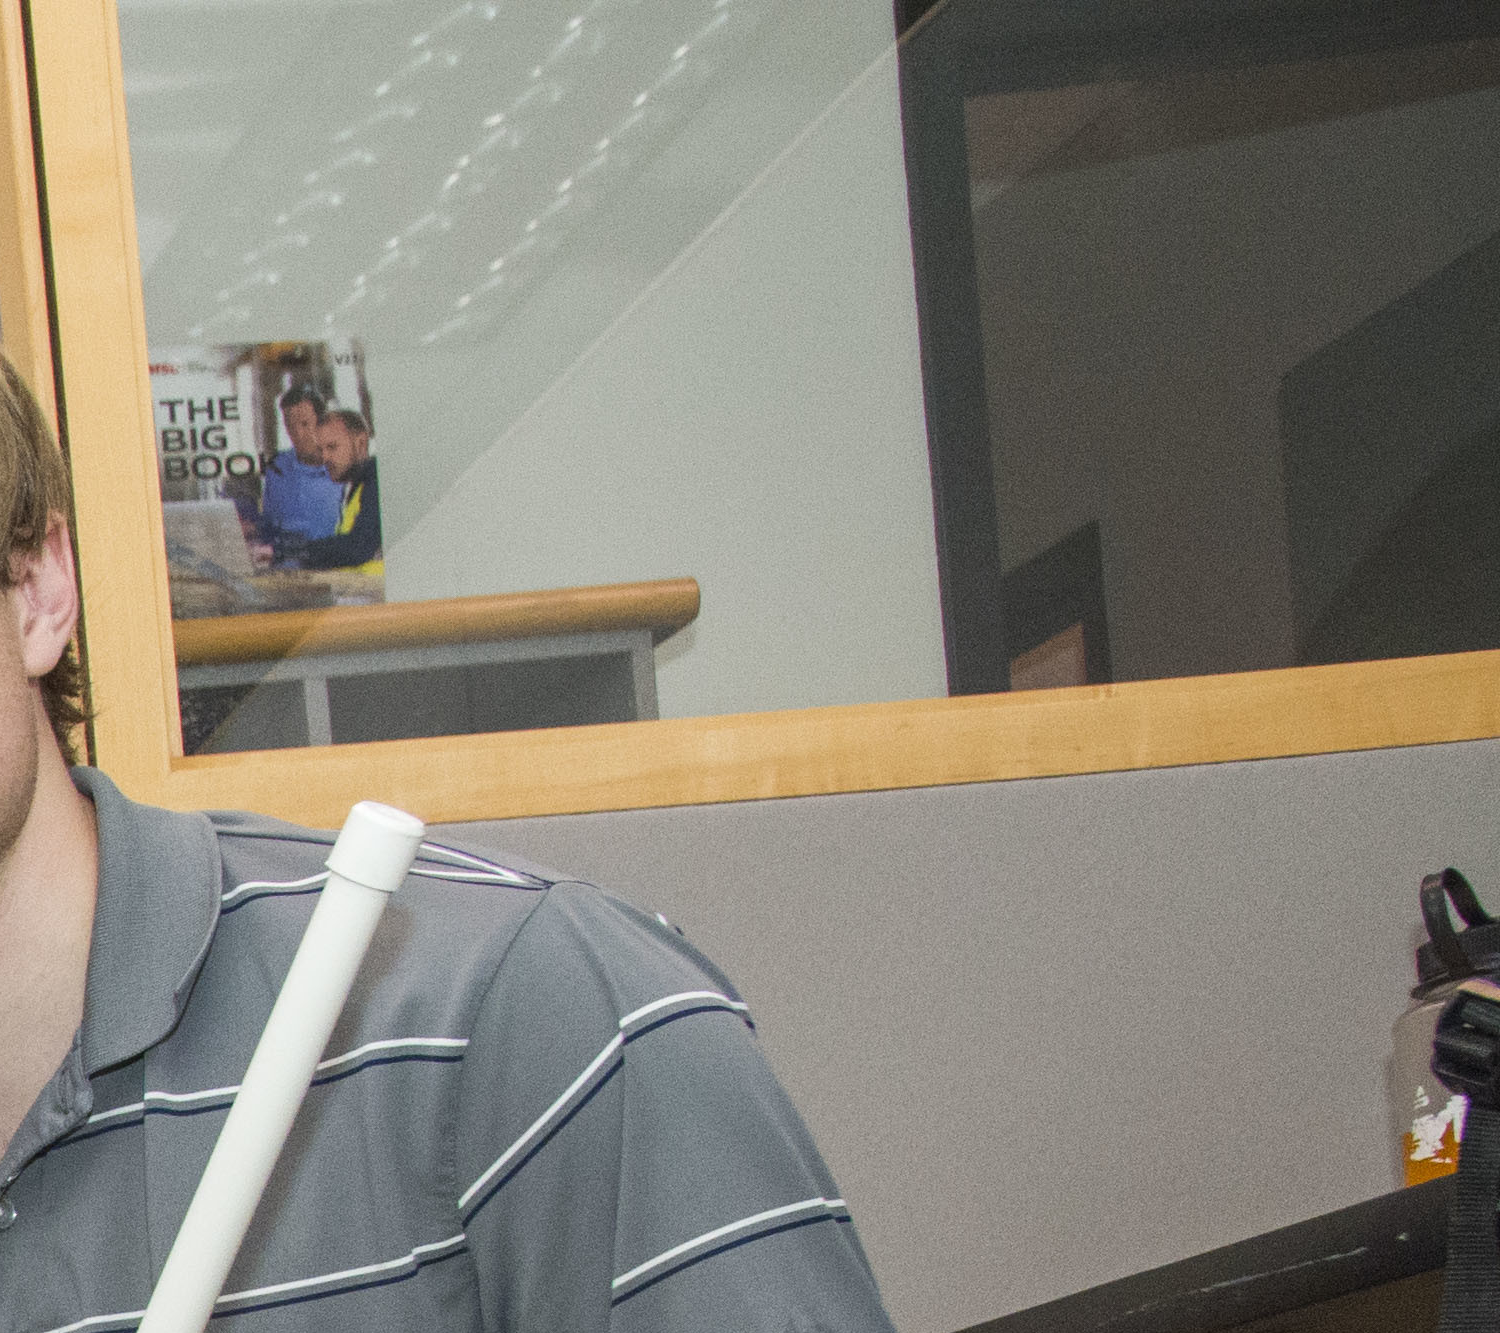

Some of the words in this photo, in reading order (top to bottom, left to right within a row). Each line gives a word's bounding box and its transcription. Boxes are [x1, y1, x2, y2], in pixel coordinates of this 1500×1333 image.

[159, 397, 240, 423] THE
[160, 425, 228, 452] BIG
[162, 452, 284, 482] BOOK
